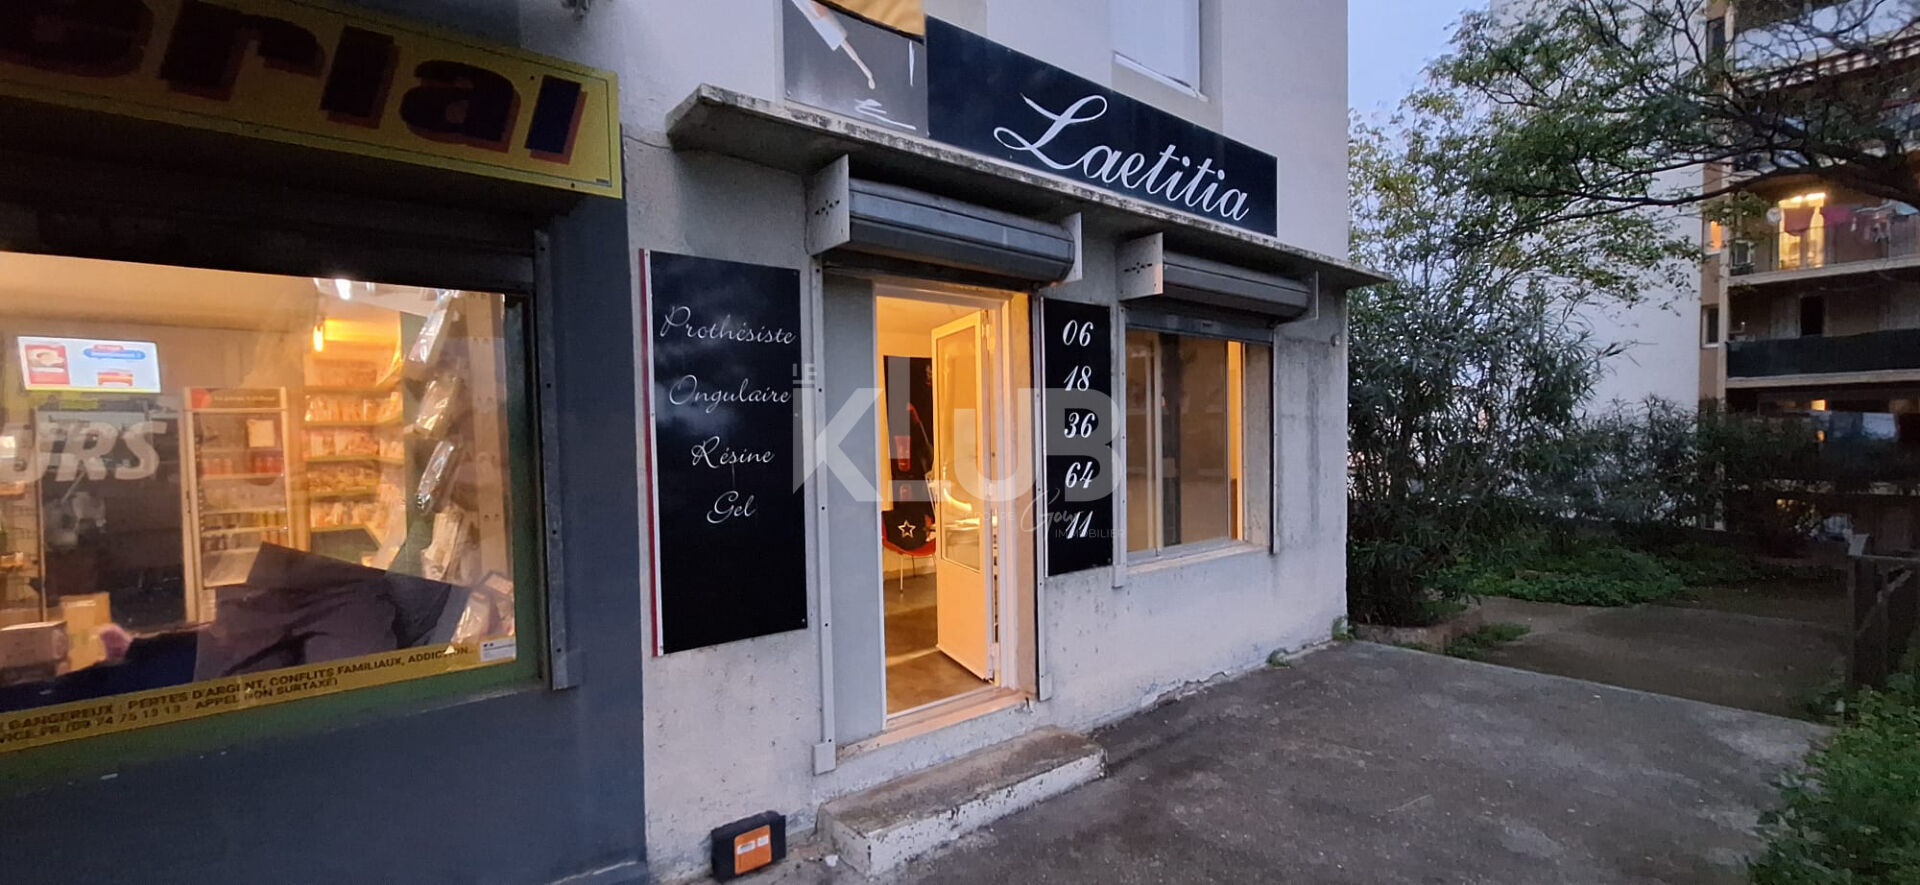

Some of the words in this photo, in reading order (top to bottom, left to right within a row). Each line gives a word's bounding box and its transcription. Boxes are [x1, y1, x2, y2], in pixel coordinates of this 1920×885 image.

[993, 94, 1250, 222] Laetitia
[659, 305, 797, 345] Prothésiste
[1061, 319, 1094, 347] 06
[669, 374, 793, 414] Ongulaire
[1063, 364, 1092, 392] 18
[1063, 411, 1096, 439] 36
[690, 435, 776, 470] Résine
[1064, 460, 1095, 489] 64
[706, 490, 758, 525] Gel
[1065, 510, 1094, 540] 11
[128, 691, 188, 709] PERTES
[270, 668, 335, 687] CONFLITS
[337, 656, 406, 675] FAMILIAUX,
[195, 693, 240, 710] APPEL
